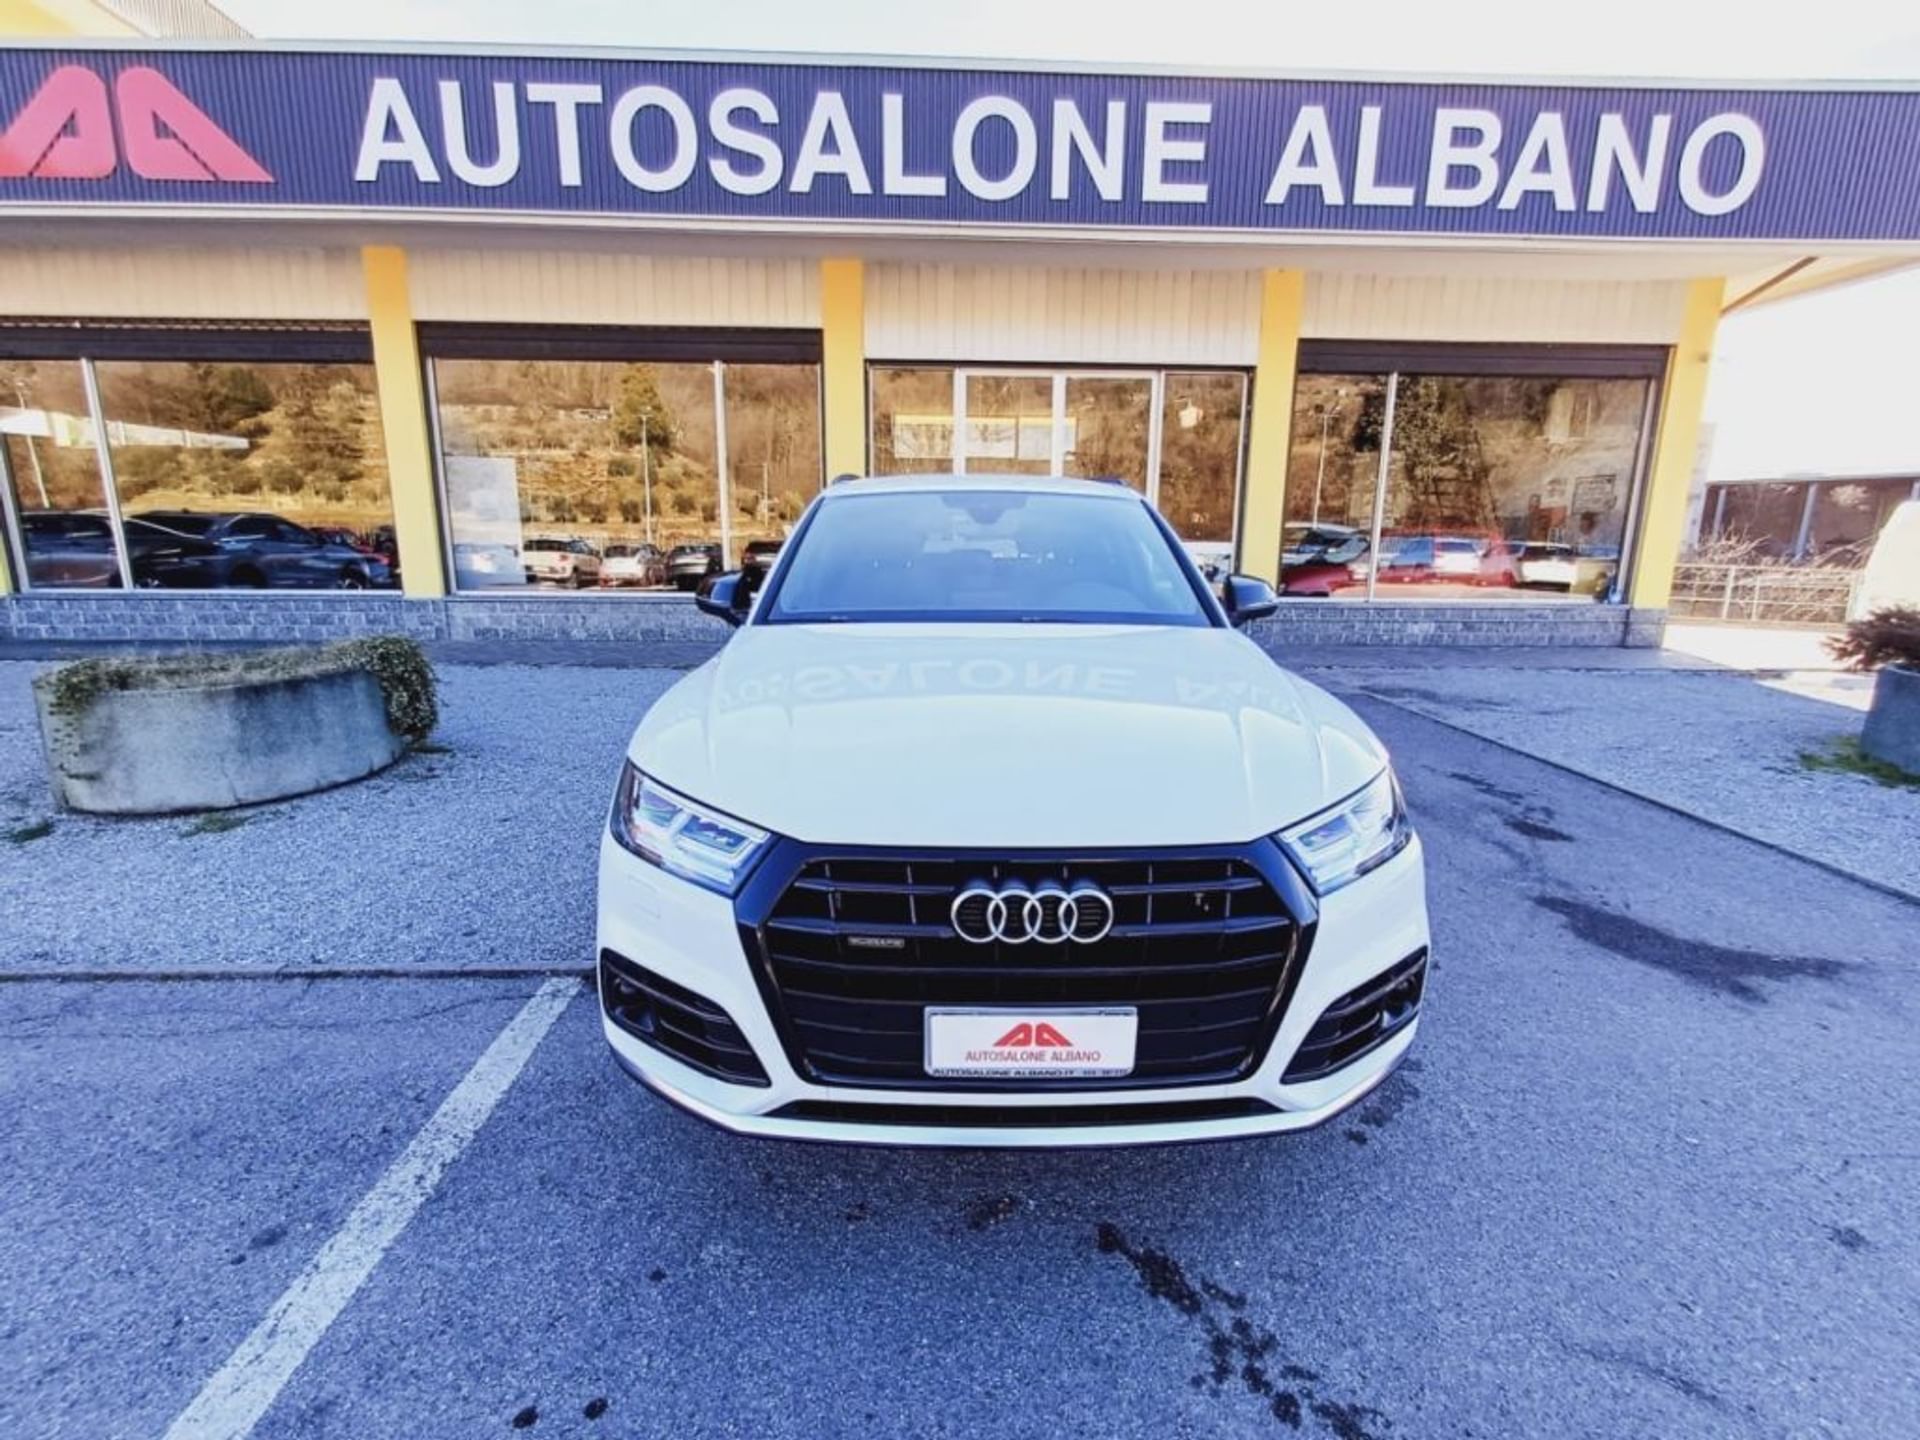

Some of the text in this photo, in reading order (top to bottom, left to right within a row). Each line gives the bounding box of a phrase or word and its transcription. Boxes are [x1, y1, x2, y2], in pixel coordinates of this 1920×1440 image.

[354, 77, 1766, 216] AUTOSALONE ALBANO
[965, 1050, 1101, 1063] AUTOSALONE ALBANO
